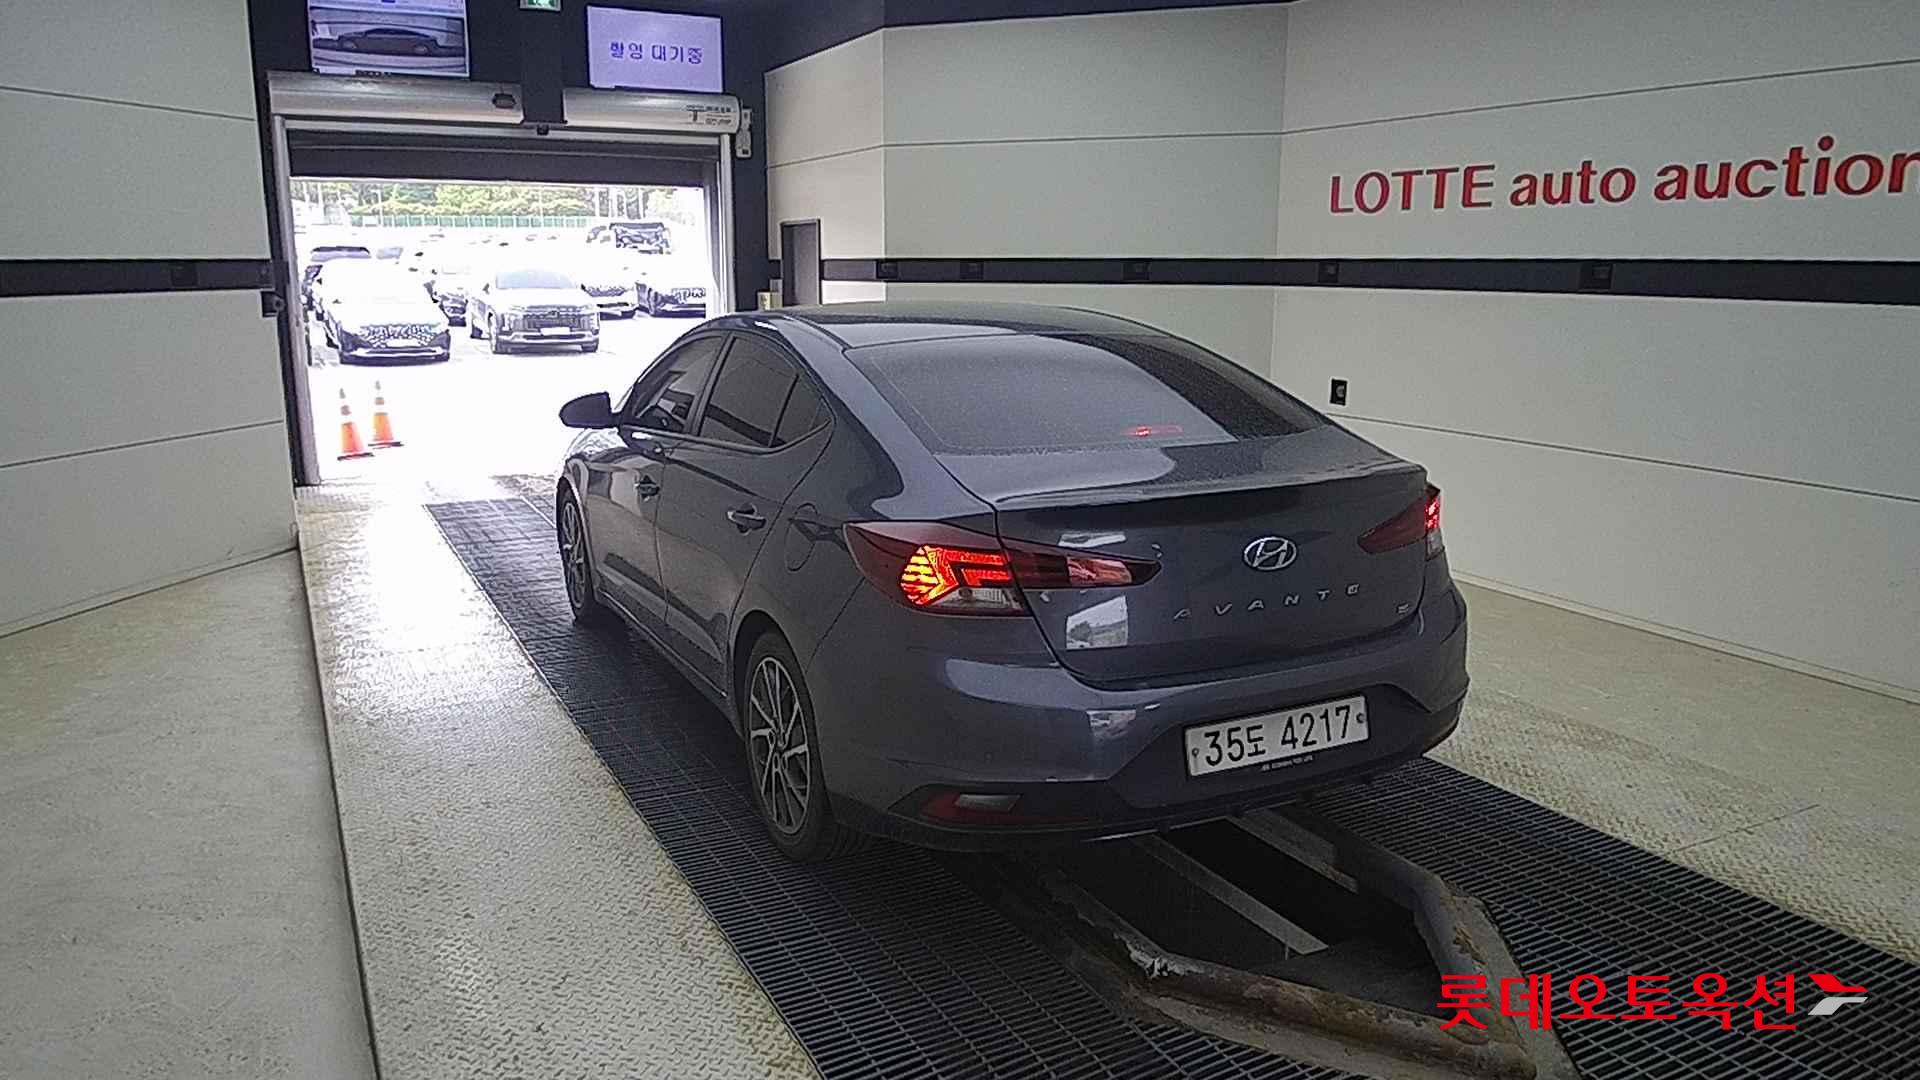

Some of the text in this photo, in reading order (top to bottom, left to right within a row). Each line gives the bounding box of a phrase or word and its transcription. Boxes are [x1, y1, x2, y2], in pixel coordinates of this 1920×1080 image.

[651, 44, 702, 65] 대기중
[1330, 164, 1495, 214] LOTTE
[1509, 160, 1637, 207] auto
[1204, 704, 1351, 767] 35도 4217
